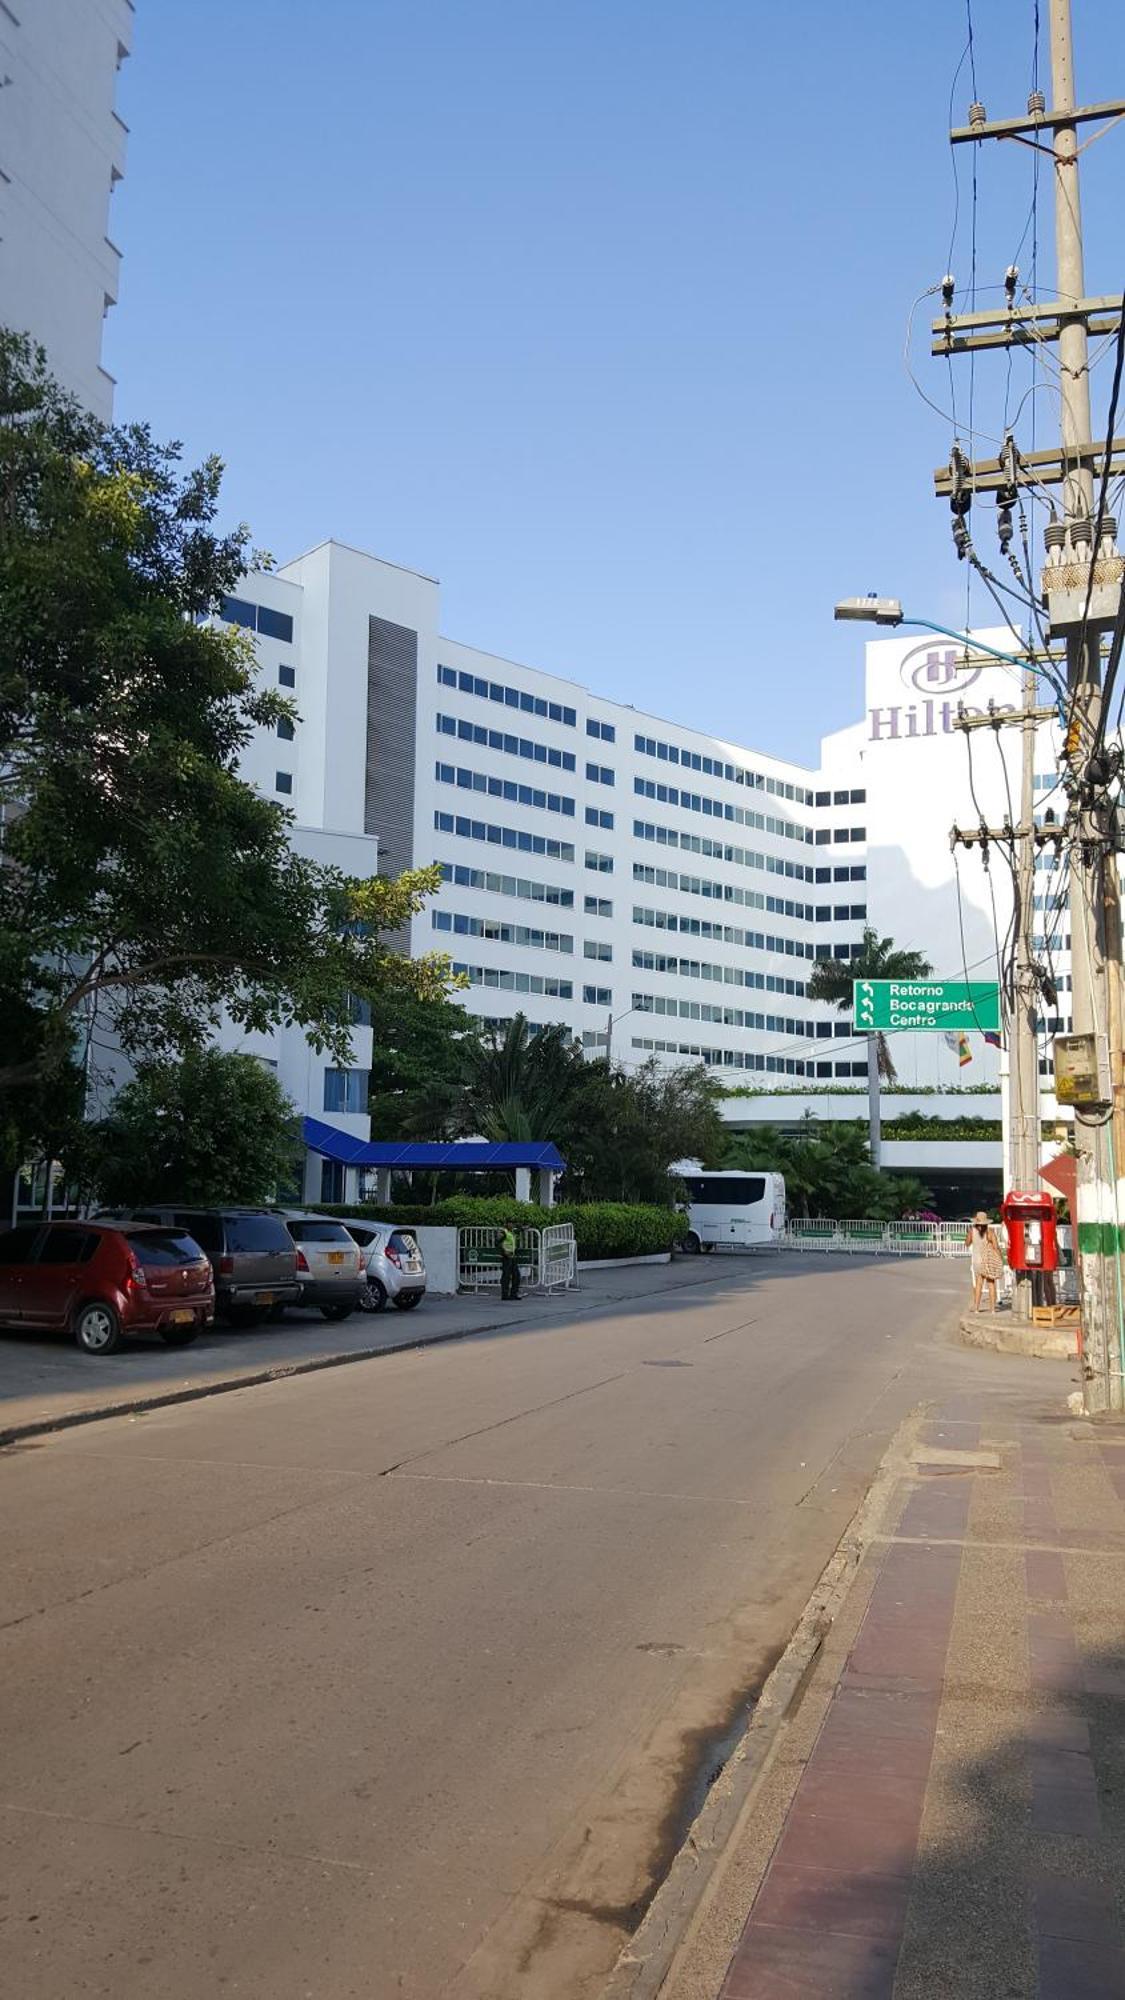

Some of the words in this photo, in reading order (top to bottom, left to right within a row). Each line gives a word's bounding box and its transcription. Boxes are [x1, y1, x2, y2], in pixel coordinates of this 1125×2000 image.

[890, 984, 944, 996] Retorno
[890, 999, 975, 1013] Bocagrande
[890, 1014, 936, 1026] Centro
